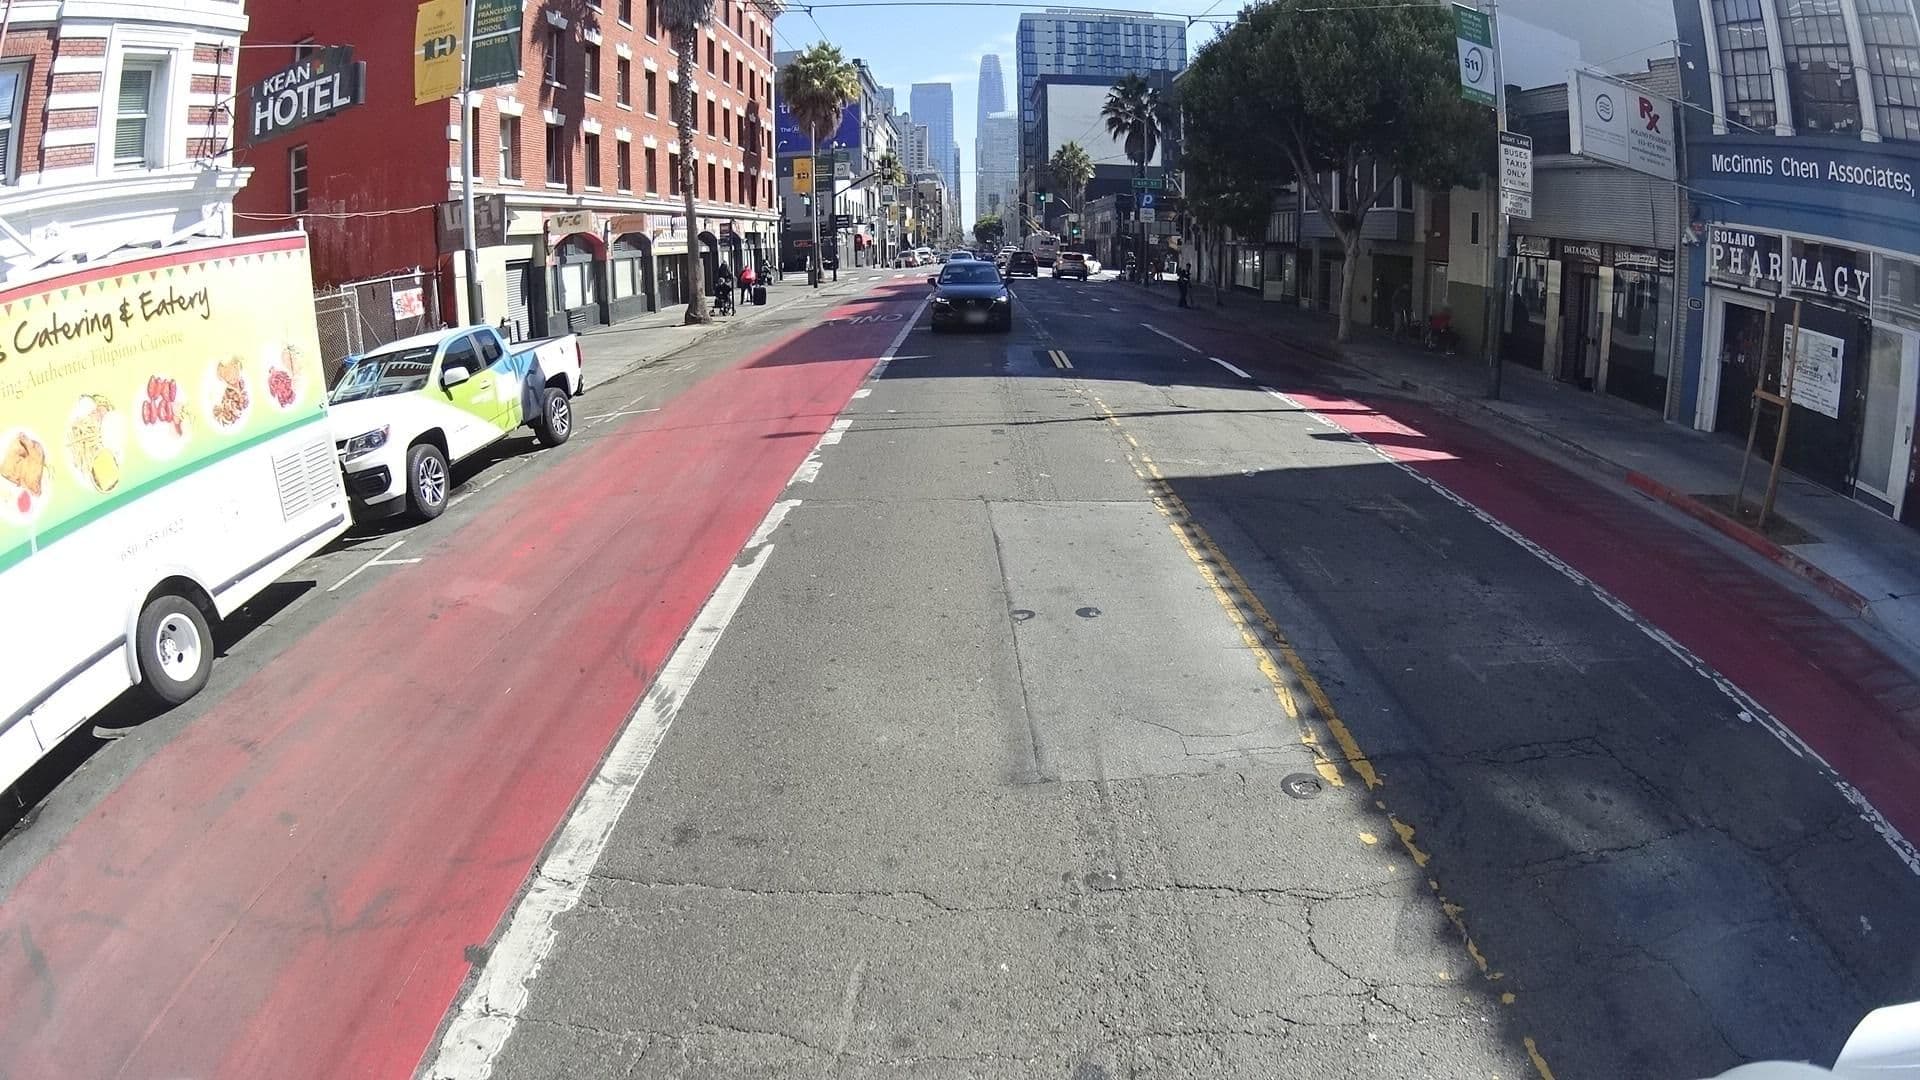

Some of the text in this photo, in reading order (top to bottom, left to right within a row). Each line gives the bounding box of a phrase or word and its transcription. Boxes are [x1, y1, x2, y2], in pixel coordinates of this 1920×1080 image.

[422, 34, 457, 61] 100
[1464, 58, 1479, 71] 511
[263, 62, 311, 96] KEAN
[254, 72, 351, 135] HOTEL
[1503, 148, 1529, 160] BUSES
[1505, 158, 1527, 169] TAXIS
[1506, 168, 1527, 178] ONLY
[1711, 153, 1916, 198] McGinnis Chen Associates,
[1563, 245, 1579, 255] DATA
[1714, 230, 1756, 248] SOLANO
[1711, 244, 1871, 302] PHARMACY
[14, 309, 114, 354] Catering
[119, 296, 134, 328] &
[139, 285, 211, 320] Eatery
[26, 359, 89, 389] Authentic
[91, 345, 138, 368] Filipino
